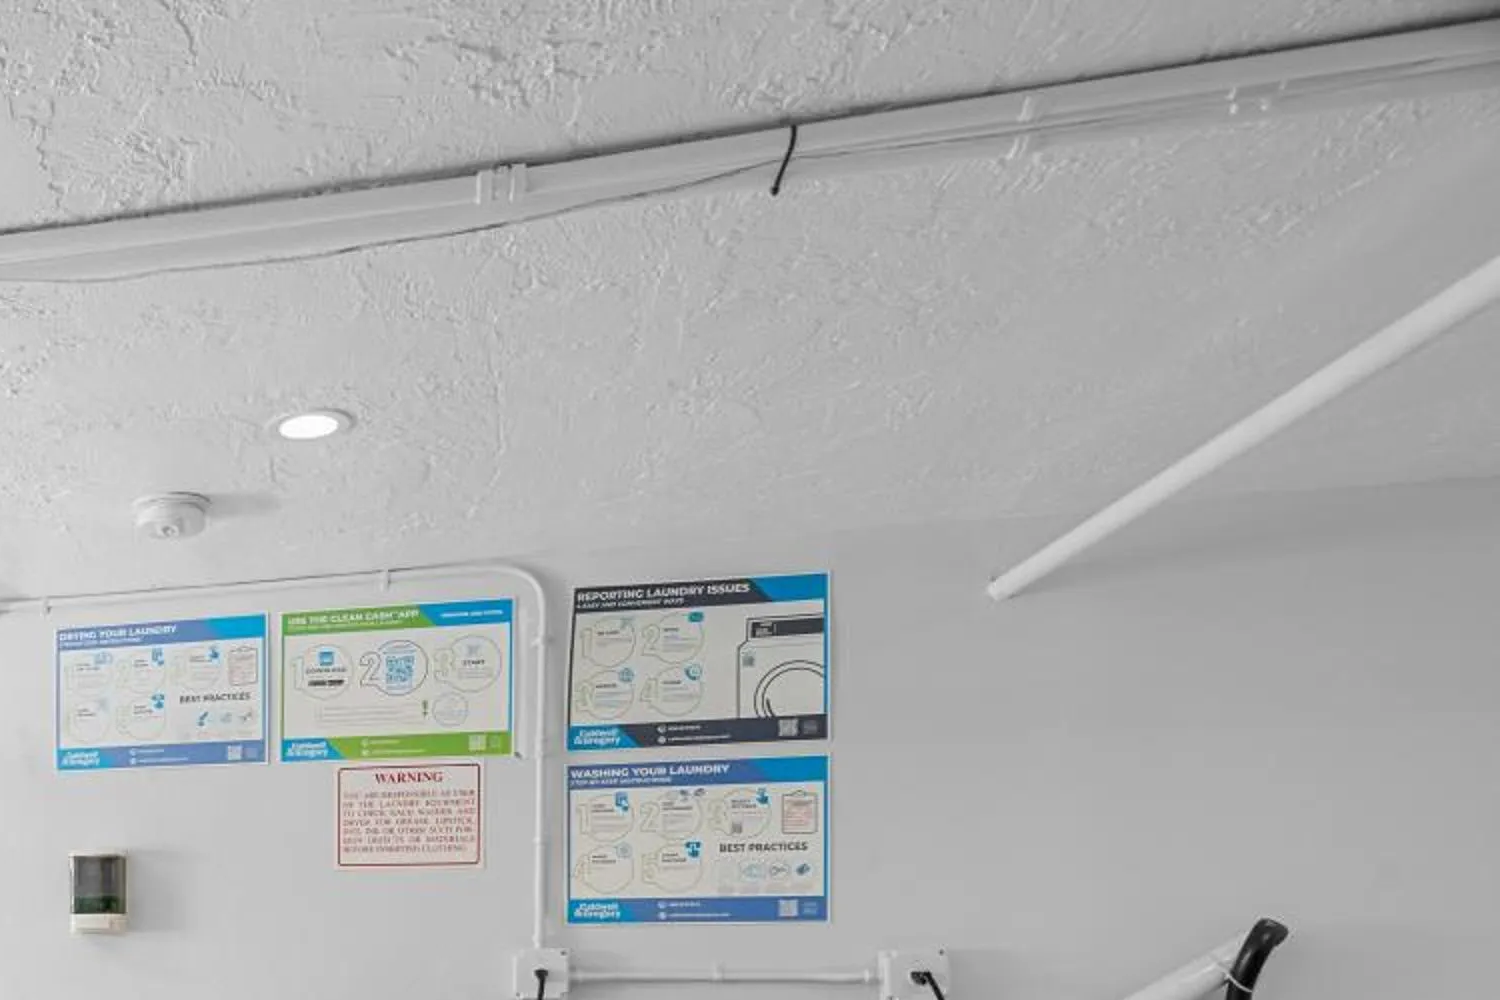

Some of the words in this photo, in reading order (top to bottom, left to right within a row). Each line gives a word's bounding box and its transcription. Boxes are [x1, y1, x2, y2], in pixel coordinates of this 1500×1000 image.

[577, 588, 644, 602] REPORTING
[646, 585, 704, 599] LAUNDRY
[706, 583, 751, 595] ISSUES
[331, 613, 364, 623] CLEAN
[59, 630, 97, 642] DRYING
[100, 627, 127, 639] YOUR
[129, 624, 177, 636] LAUNDRY
[359, 651, 381, 688] 2
[374, 771, 444, 784] WARNING
[571, 767, 629, 779] WASHING
[631, 765, 667, 777] YOUR
[669, 763, 730, 775] LAUNDRY
[719, 842, 746, 853] BEST
[747, 841, 809, 852] PRACTICES
